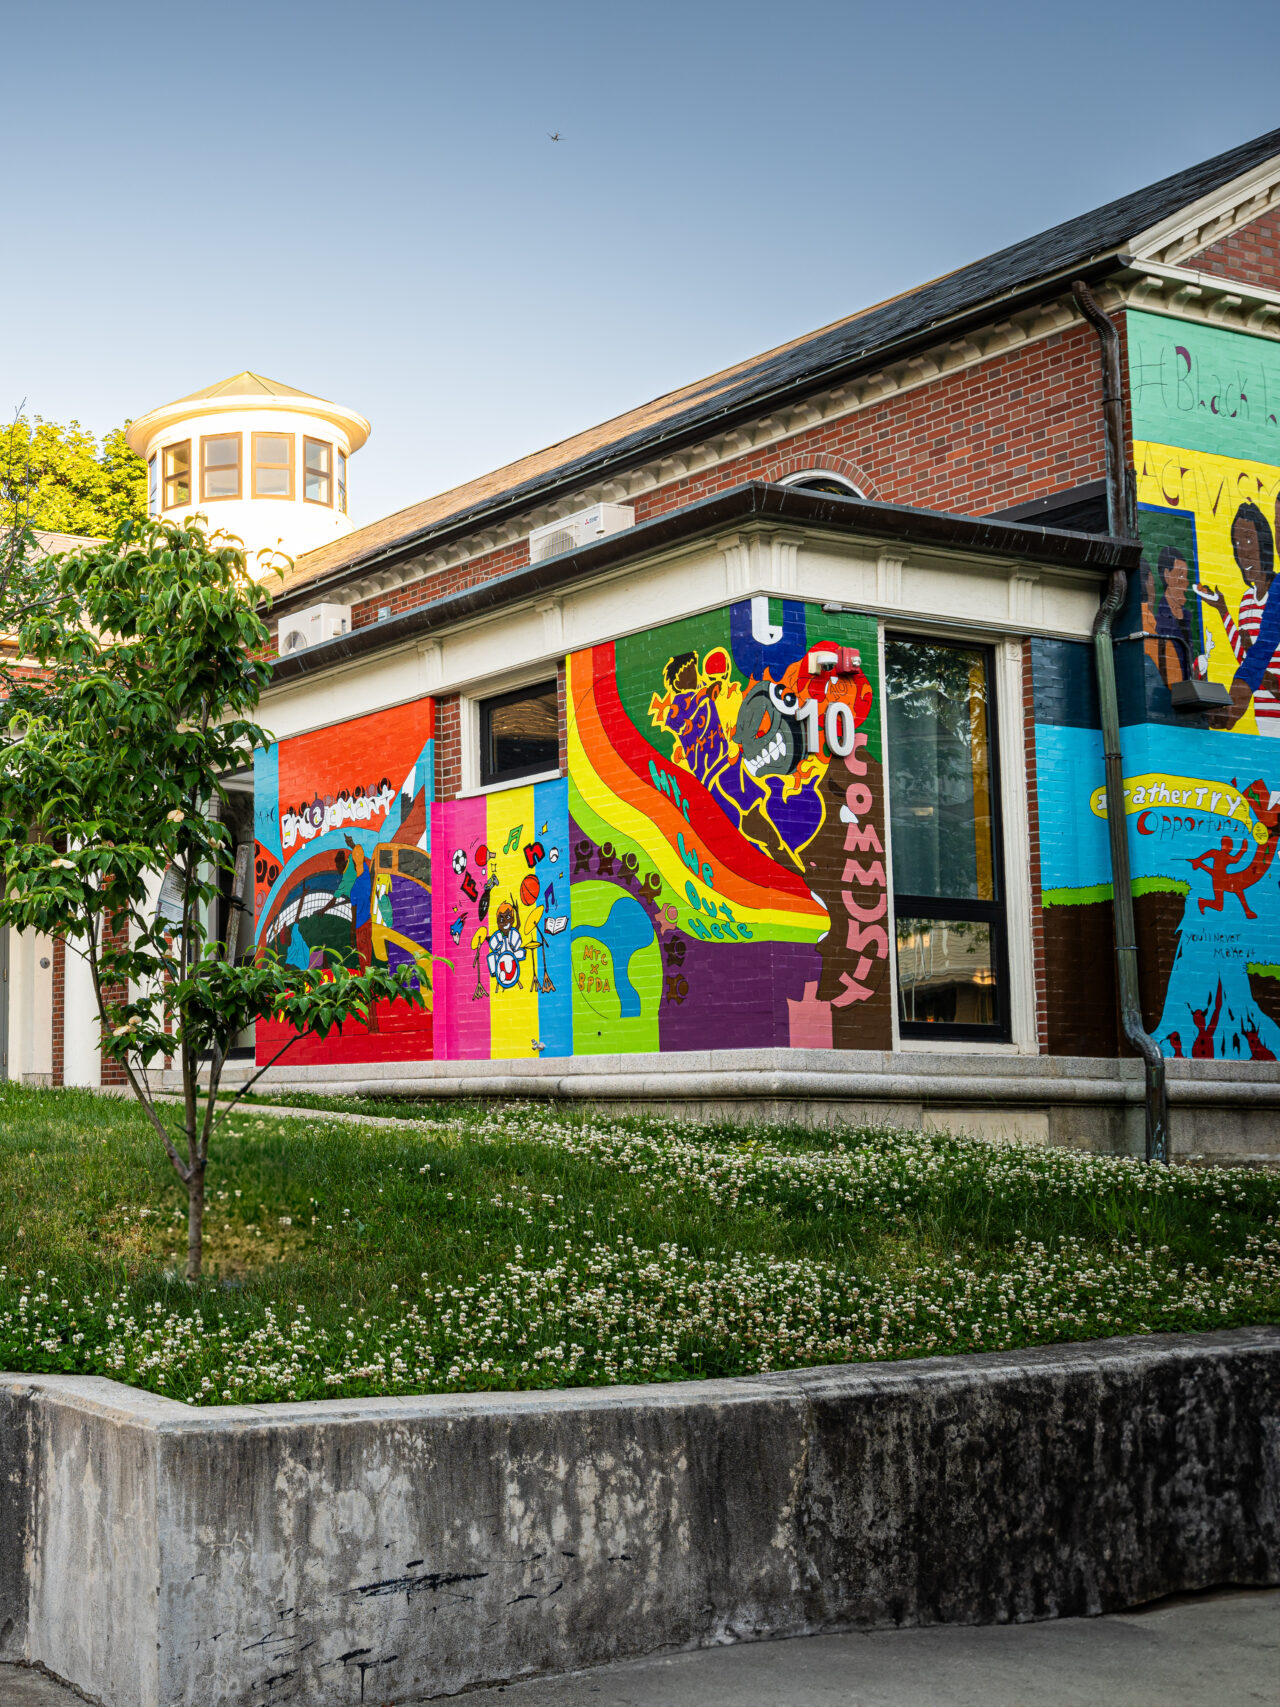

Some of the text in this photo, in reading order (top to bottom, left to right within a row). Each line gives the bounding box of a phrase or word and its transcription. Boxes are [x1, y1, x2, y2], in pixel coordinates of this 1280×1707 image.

[795, 698, 855, 758] 10
[583, 944, 608, 966] MTC
[578, 972, 611, 994] BPDA
